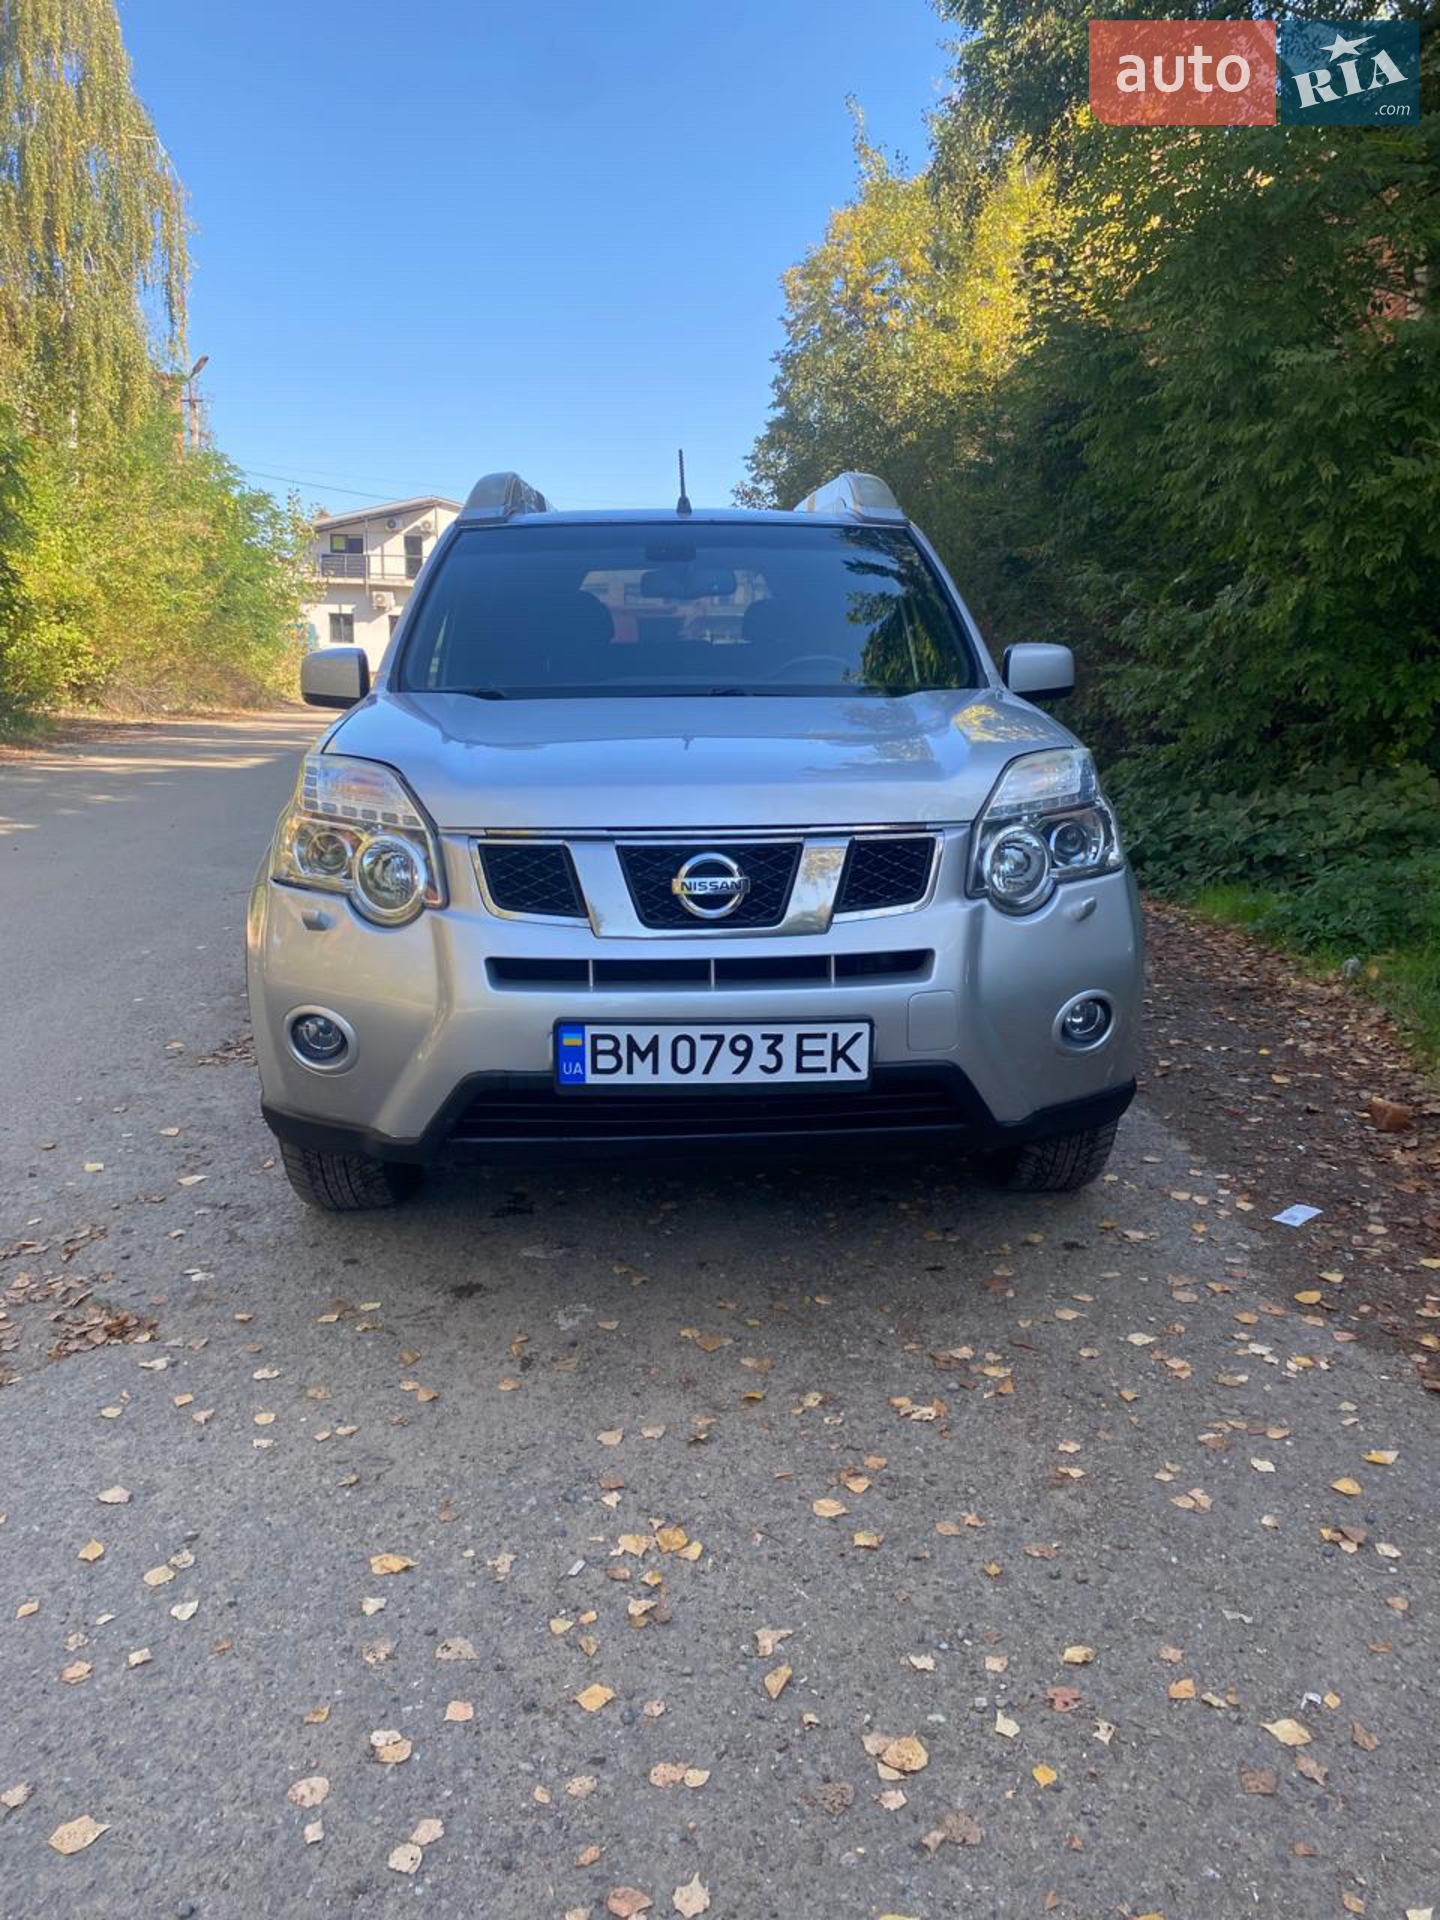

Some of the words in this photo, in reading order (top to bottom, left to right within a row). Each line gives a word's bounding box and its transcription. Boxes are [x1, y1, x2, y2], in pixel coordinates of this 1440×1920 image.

[680, 881, 741, 892] NISSAN
[590, 1033, 659, 1075] BM
[671, 1033, 783, 1075] 0793
[795, 1032, 864, 1073] EK
[563, 1062, 583, 1075] UA
